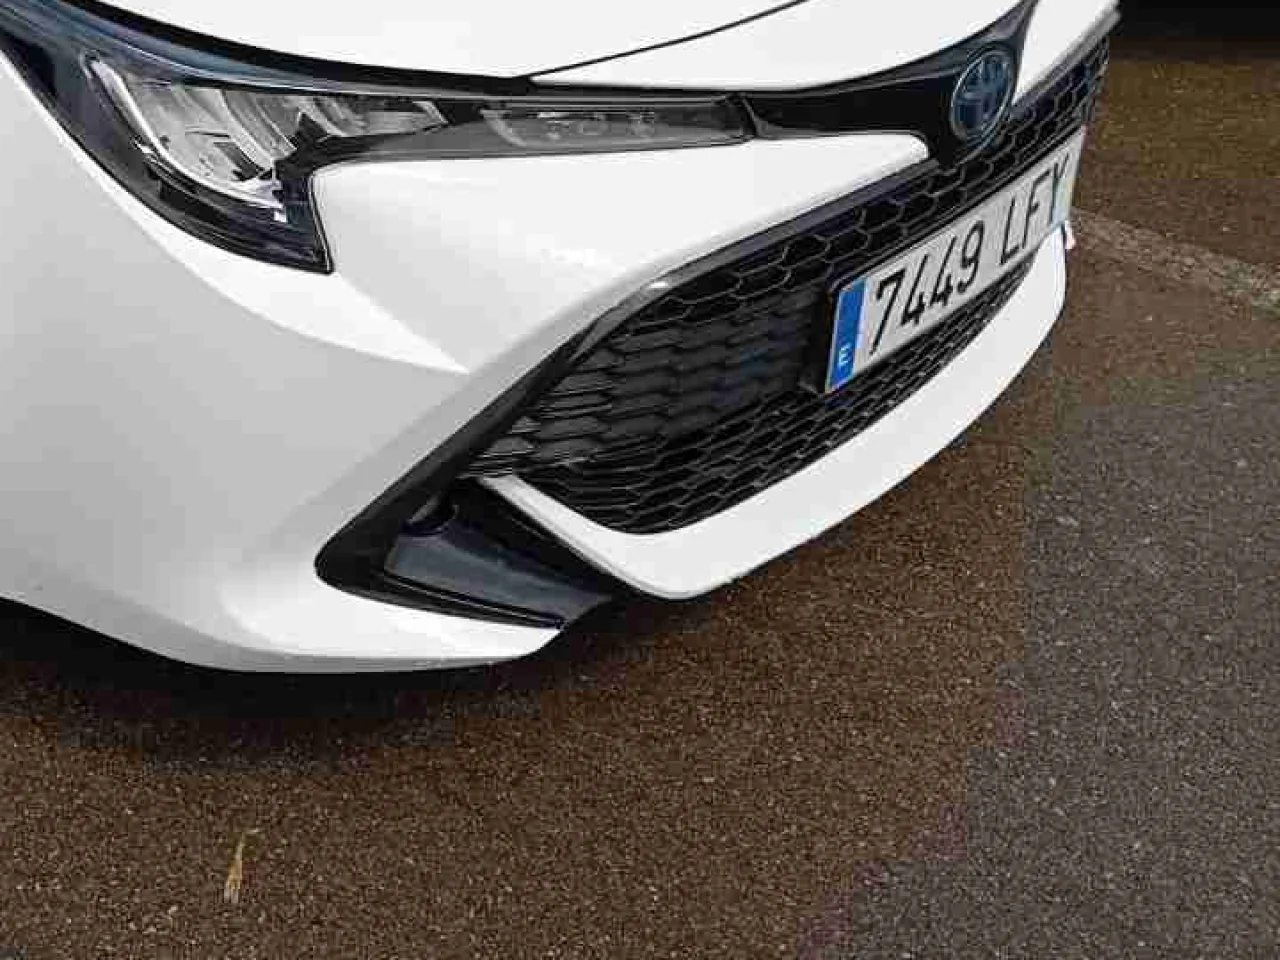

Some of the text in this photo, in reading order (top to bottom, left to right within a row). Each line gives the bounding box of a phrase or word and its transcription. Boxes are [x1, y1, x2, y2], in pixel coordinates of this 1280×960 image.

[869, 152, 1070, 356] 7449 LFY
[837, 343, 852, 366] E
